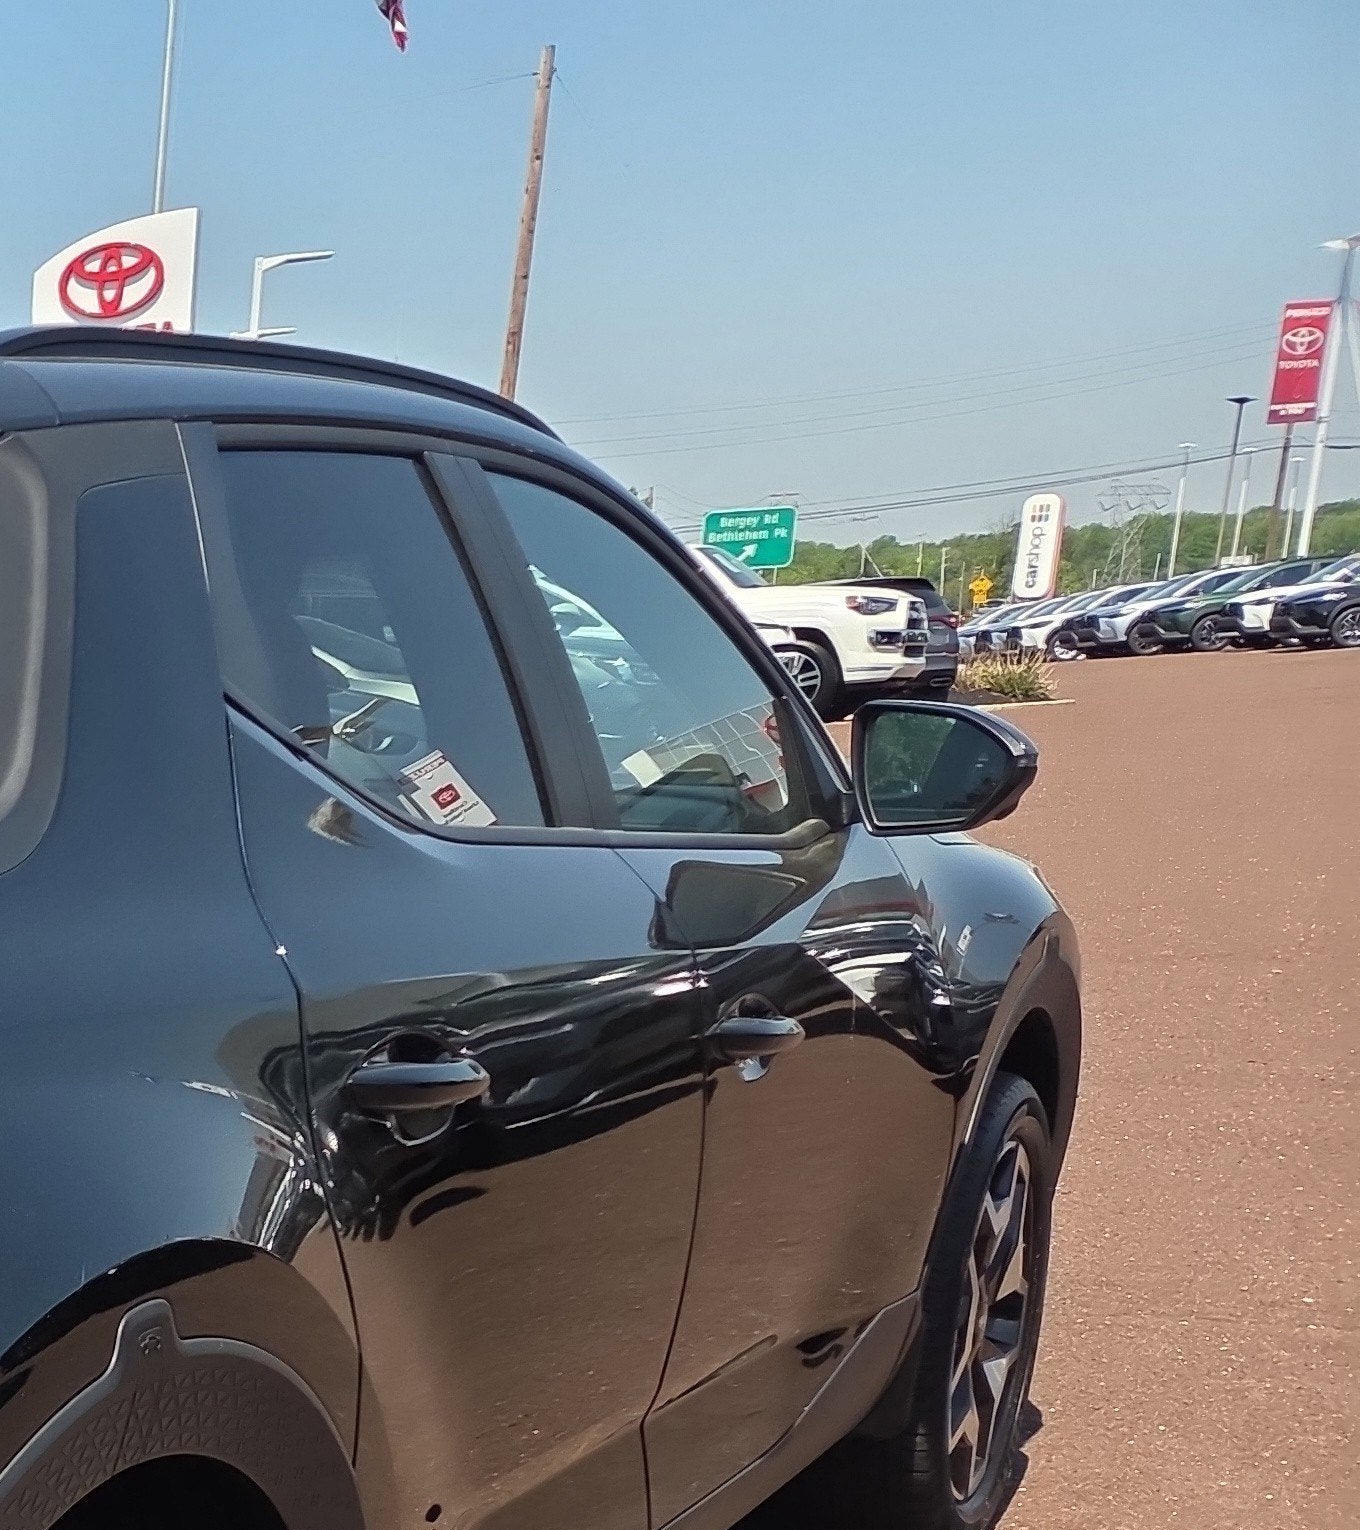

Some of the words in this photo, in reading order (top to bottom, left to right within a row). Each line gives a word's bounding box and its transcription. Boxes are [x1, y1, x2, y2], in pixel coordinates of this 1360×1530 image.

[1280, 359, 1320, 369] TOYOTA
[764, 513, 780, 525] Rd
[708, 528, 770, 543] Bethlehem
[774, 527, 788, 538] Pk
[1024, 526, 1047, 589] carshop
